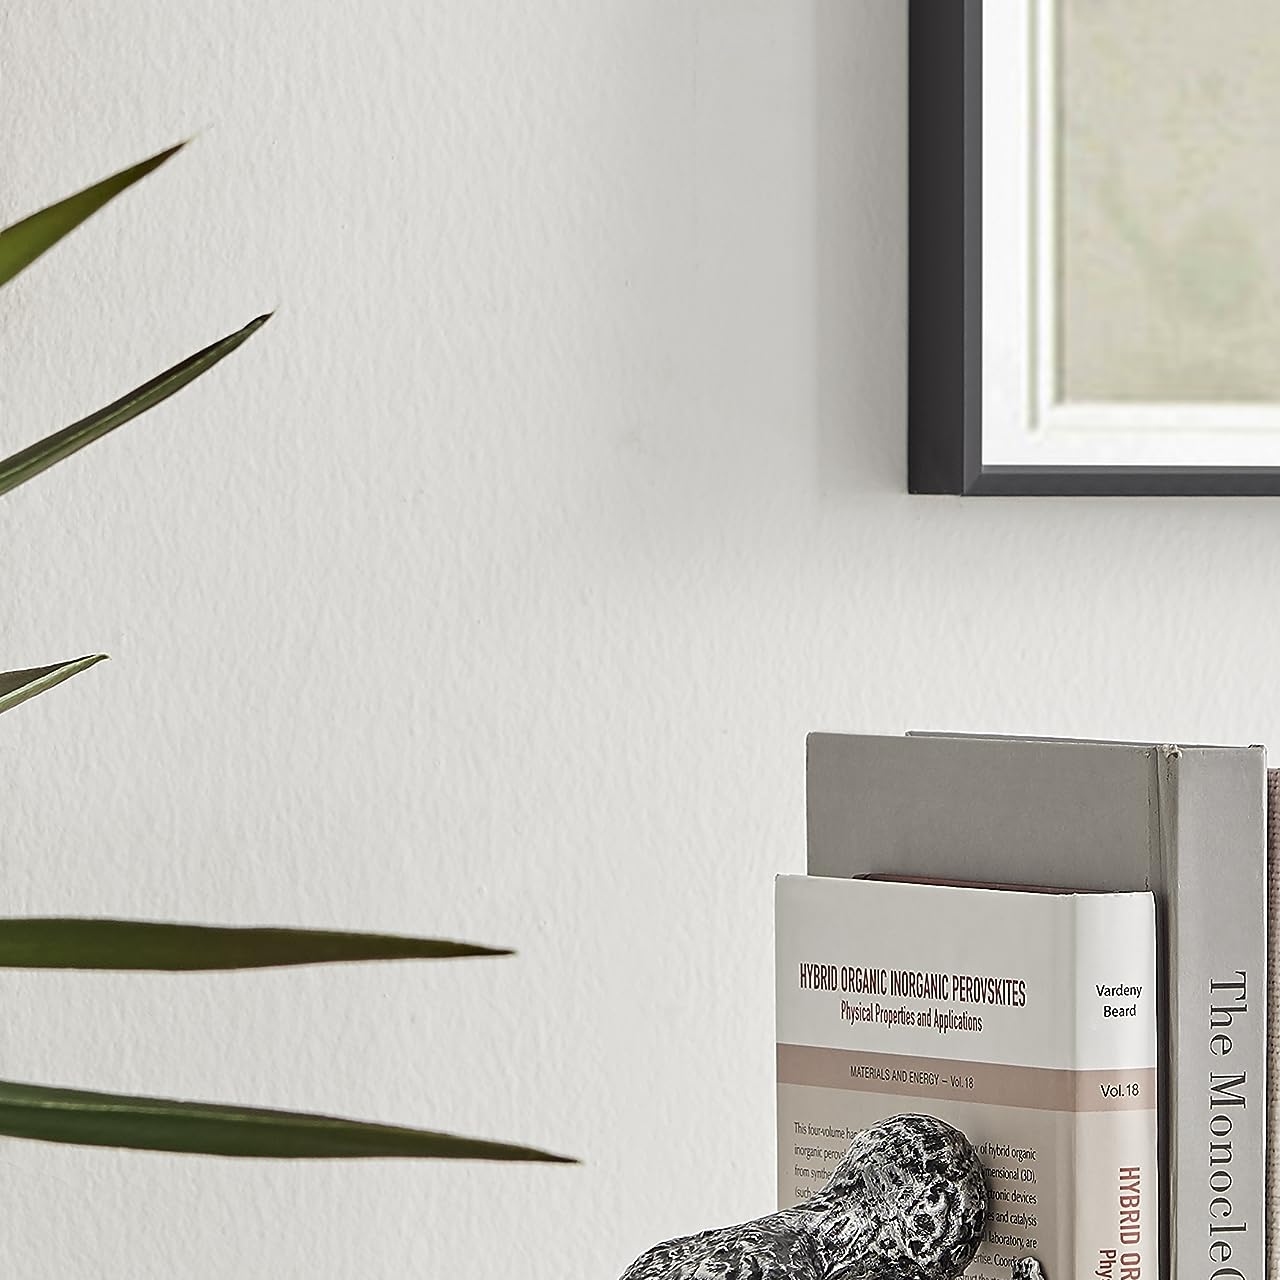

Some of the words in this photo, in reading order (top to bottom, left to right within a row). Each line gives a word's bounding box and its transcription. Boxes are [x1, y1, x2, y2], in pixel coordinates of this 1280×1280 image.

[799, 962, 838, 991] HYBRID
[840, 966, 888, 996] ORGANIC
[890, 970, 950, 1001] INORGANIC
[952, 975, 1027, 1007] PEROVSKITES
[1095, 983, 1143, 999] Vardeny
[841, 1000, 874, 1025] Physical
[875, 1004, 915, 1029] Properties
[916, 1008, 932, 1027] and
[933, 1009, 983, 1034] Applications
[1103, 1004, 1137, 1019] Beard
[1209, 970, 1248, 1056] The
[850, 1065, 890, 1081] MATERIALS
[891, 1069, 908, 1083] AND
[909, 1072, 940, 1086] ENERGY
[795, 1121, 807, 1136] This
[808, 1123, 846, 1139] four-volume
[794, 1143, 822, 1161] inorganic
[989, 1143, 1010, 1160] hybrid
[1011, 1148, 1038, 1164] organic
[794, 1164, 810, 1178] from
[1011, 1190, 1039, 1205] devices
[1119, 1166, 1141, 1246] HYBRID
[995, 1210, 1009, 1223] and
[1010, 1213, 1039, 1230] catalysis
[1025, 1238, 1038, 1249] are
